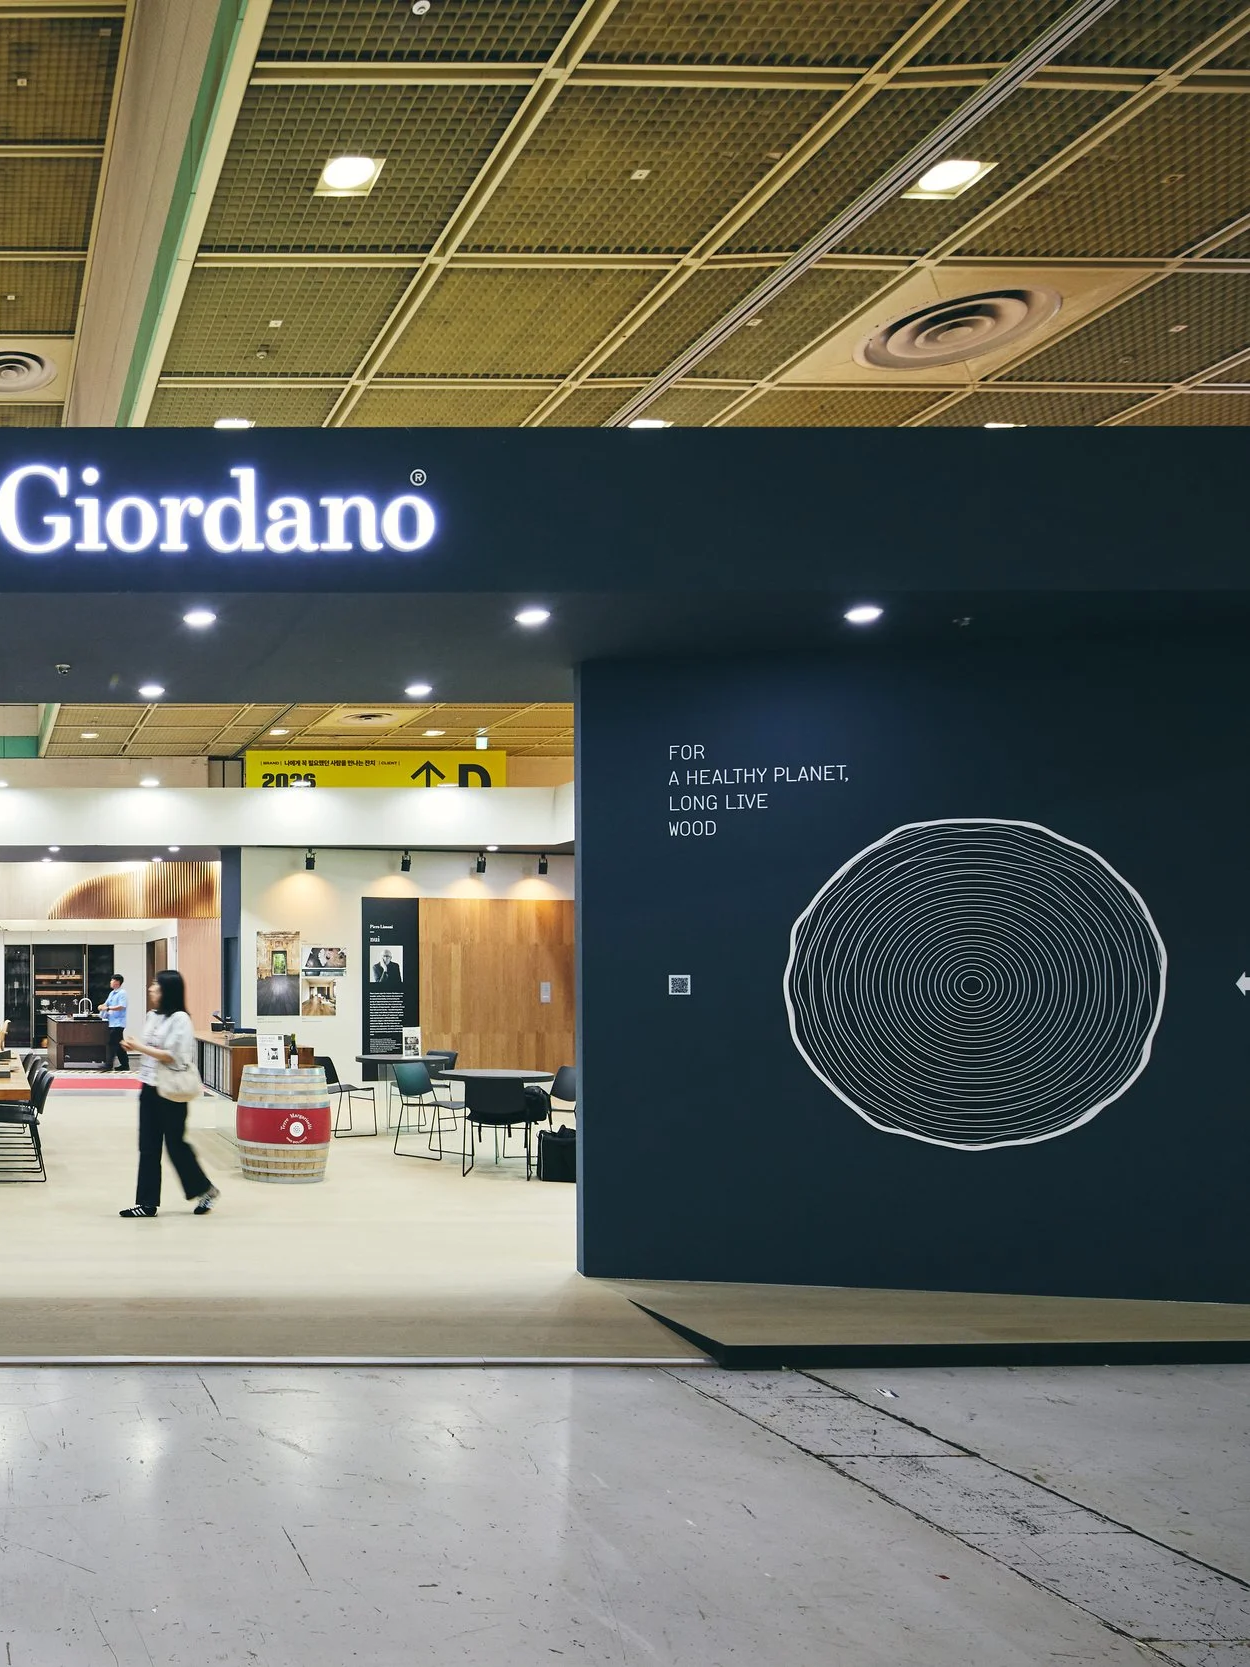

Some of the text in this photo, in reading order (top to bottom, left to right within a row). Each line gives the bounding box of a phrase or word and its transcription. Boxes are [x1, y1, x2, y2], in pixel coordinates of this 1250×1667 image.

[668, 744, 706, 761] FOR
[668, 764, 850, 786] A HEALTHY PLANET,
[668, 793, 769, 811] LONG LIVE
[668, 820, 717, 837] WOOD
